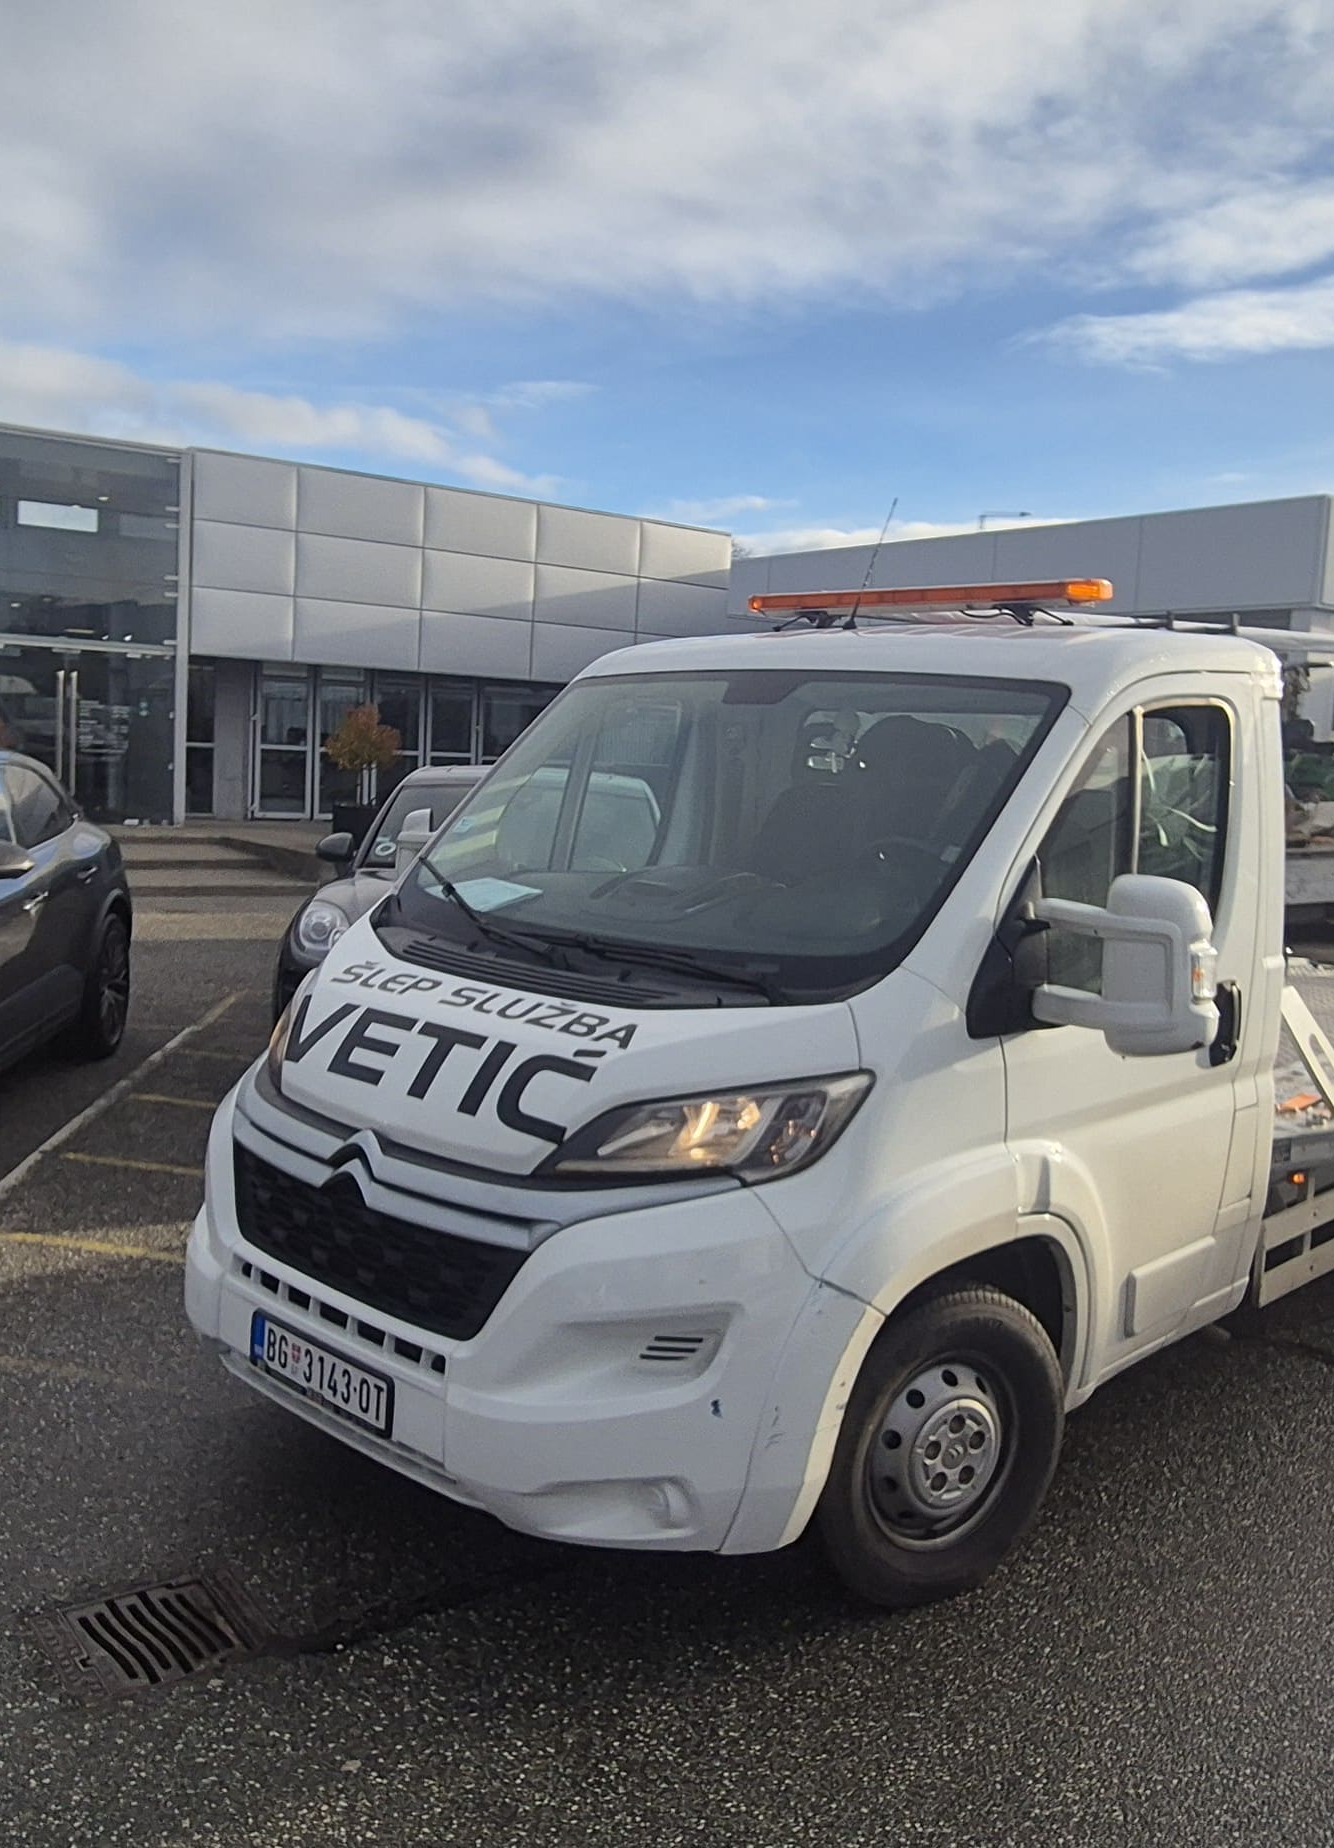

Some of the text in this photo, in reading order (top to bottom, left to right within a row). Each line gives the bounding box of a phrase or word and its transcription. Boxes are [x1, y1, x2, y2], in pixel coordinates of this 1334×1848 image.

[330, 960, 638, 1050] ŠLEP SLUŽBA
[284, 994, 607, 1146] VETIĆ
[267, 1327, 289, 1369] BG
